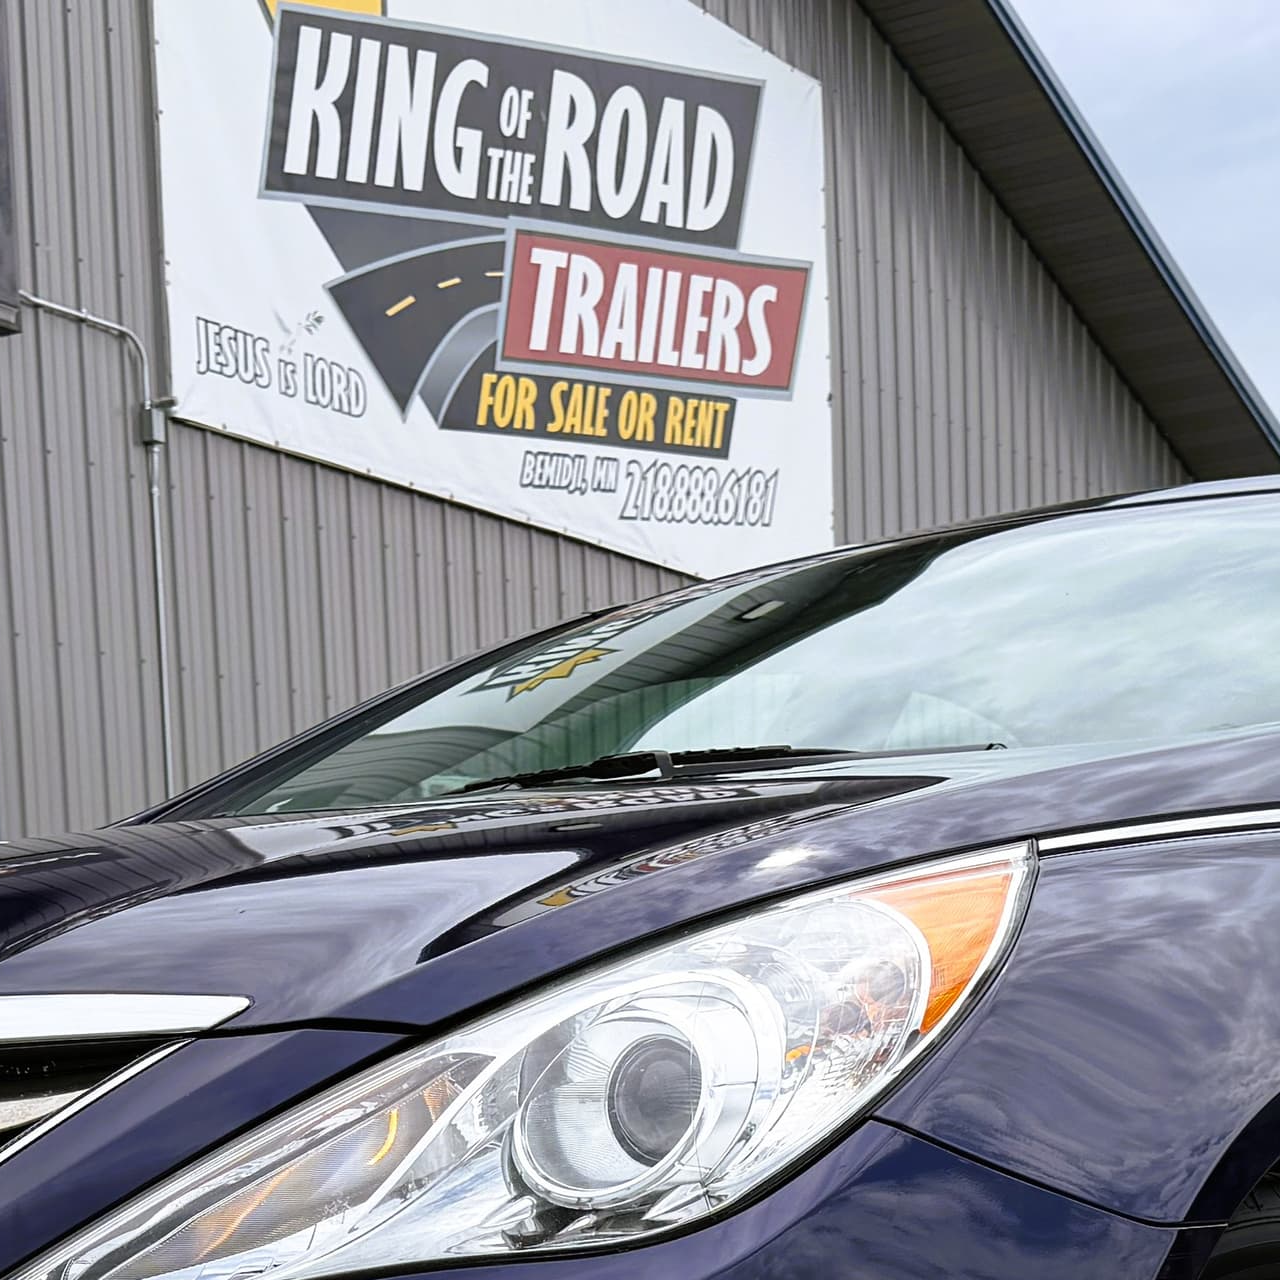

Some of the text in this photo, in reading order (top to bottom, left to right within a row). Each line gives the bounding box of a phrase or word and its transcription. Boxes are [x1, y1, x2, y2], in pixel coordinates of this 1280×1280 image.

[283, 25, 735, 231] KING OF THE ROAD
[528, 246, 778, 377] TRAILERS
[196, 316, 367, 418] JESUS IS LORD
[476, 372, 731, 449] FOR SALE OR RENT
[520, 450, 779, 527] BEMIDJI, MN 218.888.6181
